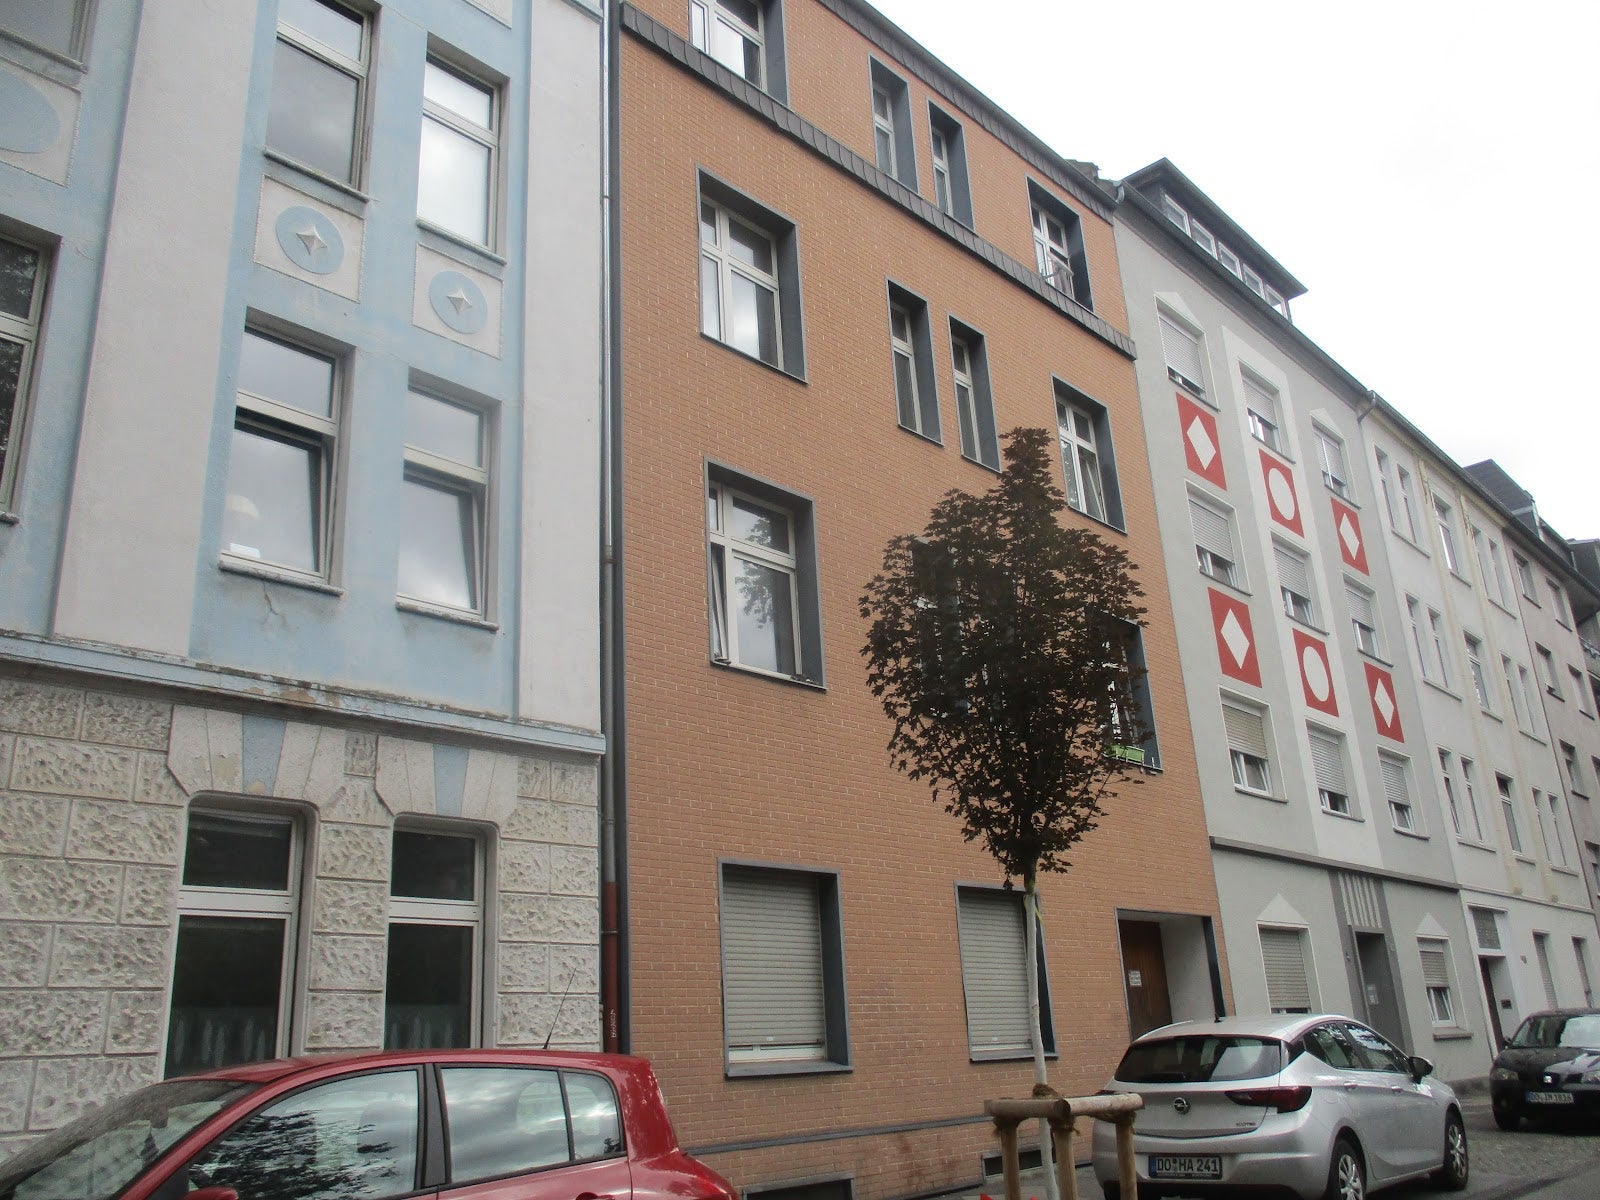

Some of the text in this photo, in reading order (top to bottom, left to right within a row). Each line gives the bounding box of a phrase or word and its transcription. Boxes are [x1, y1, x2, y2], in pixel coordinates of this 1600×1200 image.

[1157, 1158, 1218, 1173] DO HA 241
